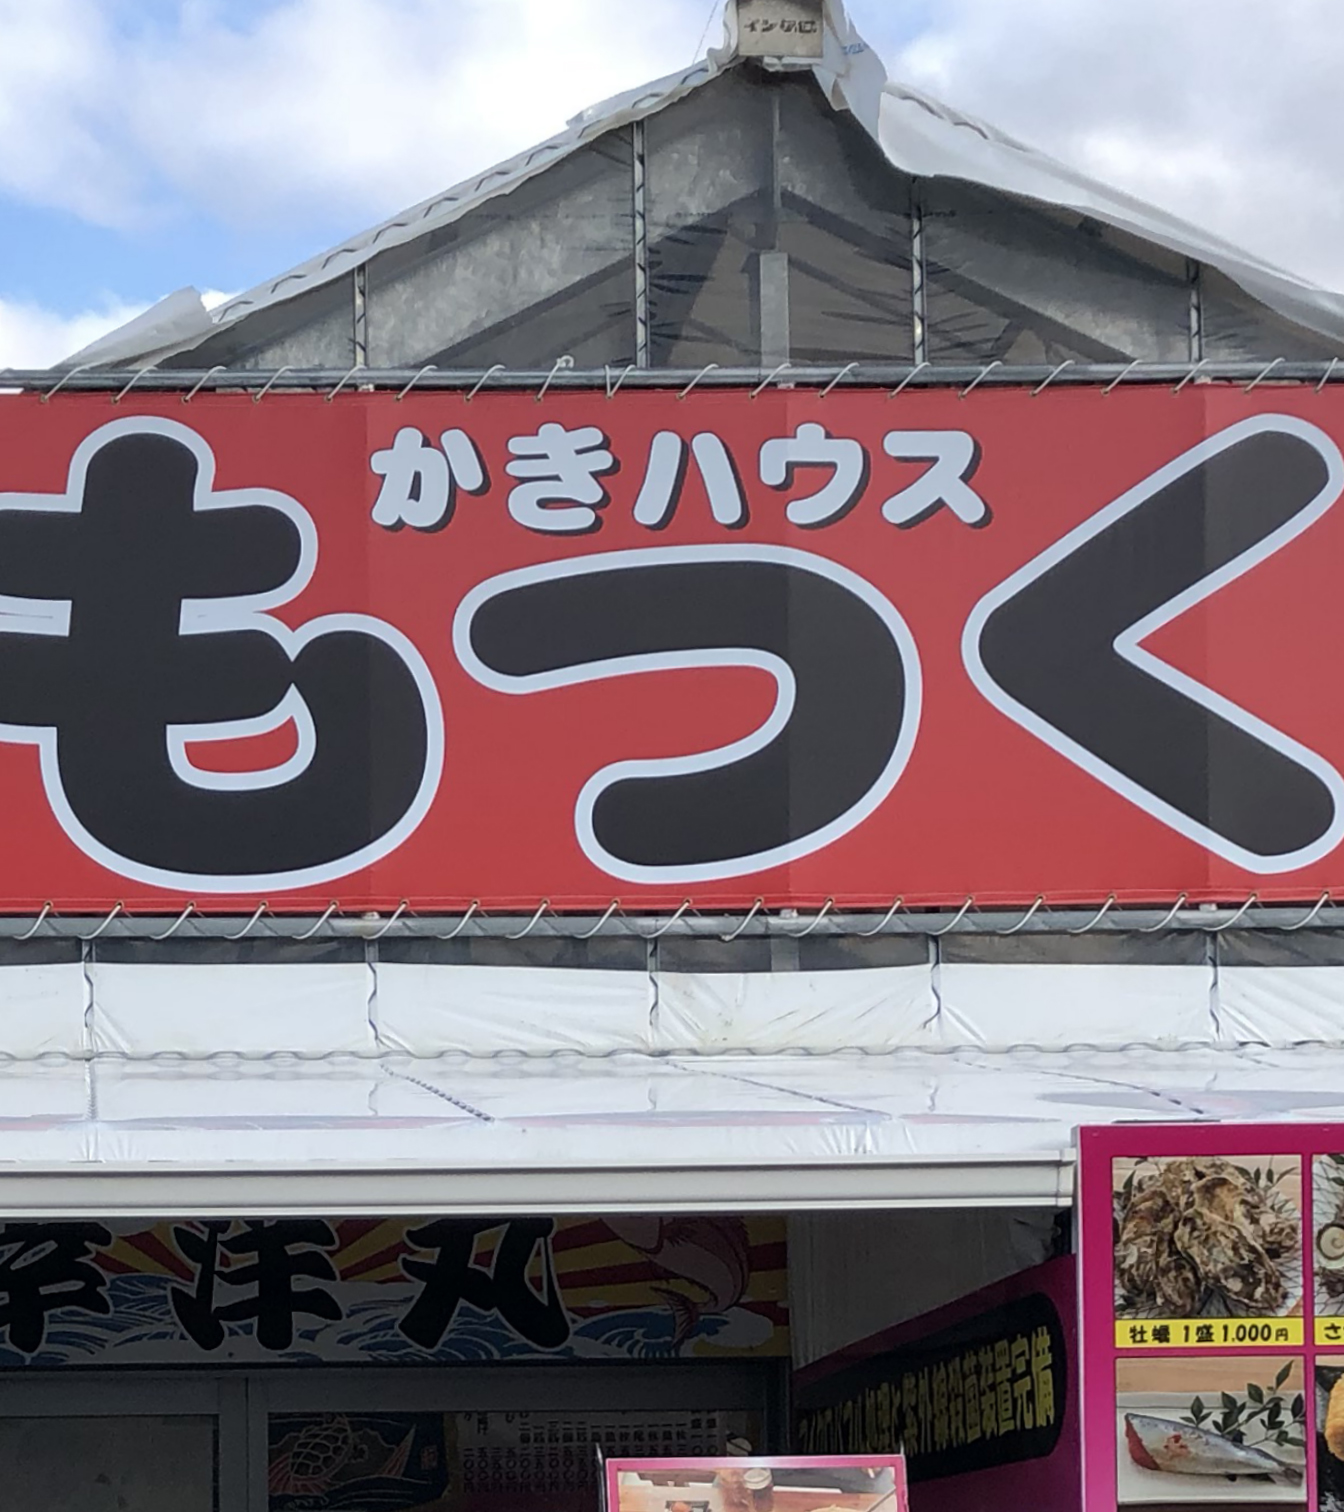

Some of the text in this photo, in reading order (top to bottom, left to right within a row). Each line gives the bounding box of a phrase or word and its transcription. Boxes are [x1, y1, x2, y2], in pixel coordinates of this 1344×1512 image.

[370, 418, 991, 534] かきハウス
[1128, 1324, 1174, 1344] 牡蠣
[1181, 1324, 1216, 1343] 1盛
